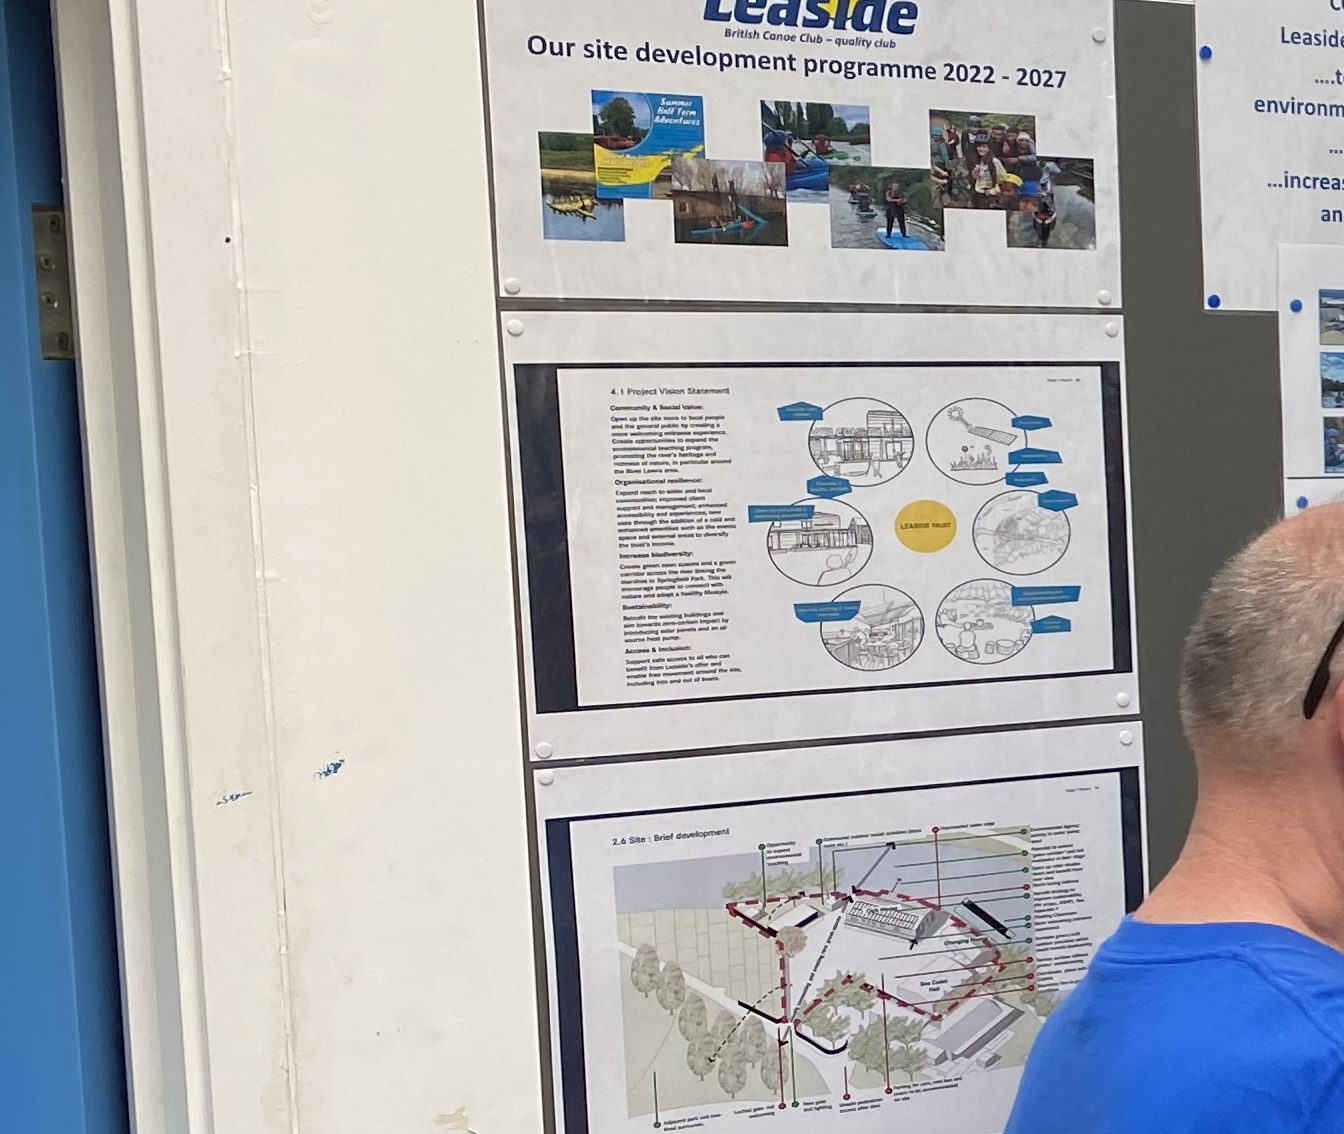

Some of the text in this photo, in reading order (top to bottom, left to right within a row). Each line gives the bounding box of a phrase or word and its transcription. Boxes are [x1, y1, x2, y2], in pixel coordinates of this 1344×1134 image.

[724, 27, 760, 40] British
[762, 30, 797, 42] Canoe
[799, 32, 823, 44] Club
[834, 36, 872, 49] quality
[873, 37, 896, 48] club
[527, 34, 576, 57] Our
[583, 38, 628, 60] site
[635, 41, 797, 72] development
[803, 57, 936, 80] programme
[943, 62, 995, 84] 2022
[1016, 67, 1066, 88] 2027
[627, 388, 657, 397] Project
[659, 387, 685, 396] Vision
[611, 836, 627, 846] 2.6
[653, 832, 674, 842] Brief
[675, 827, 730, 840] development
